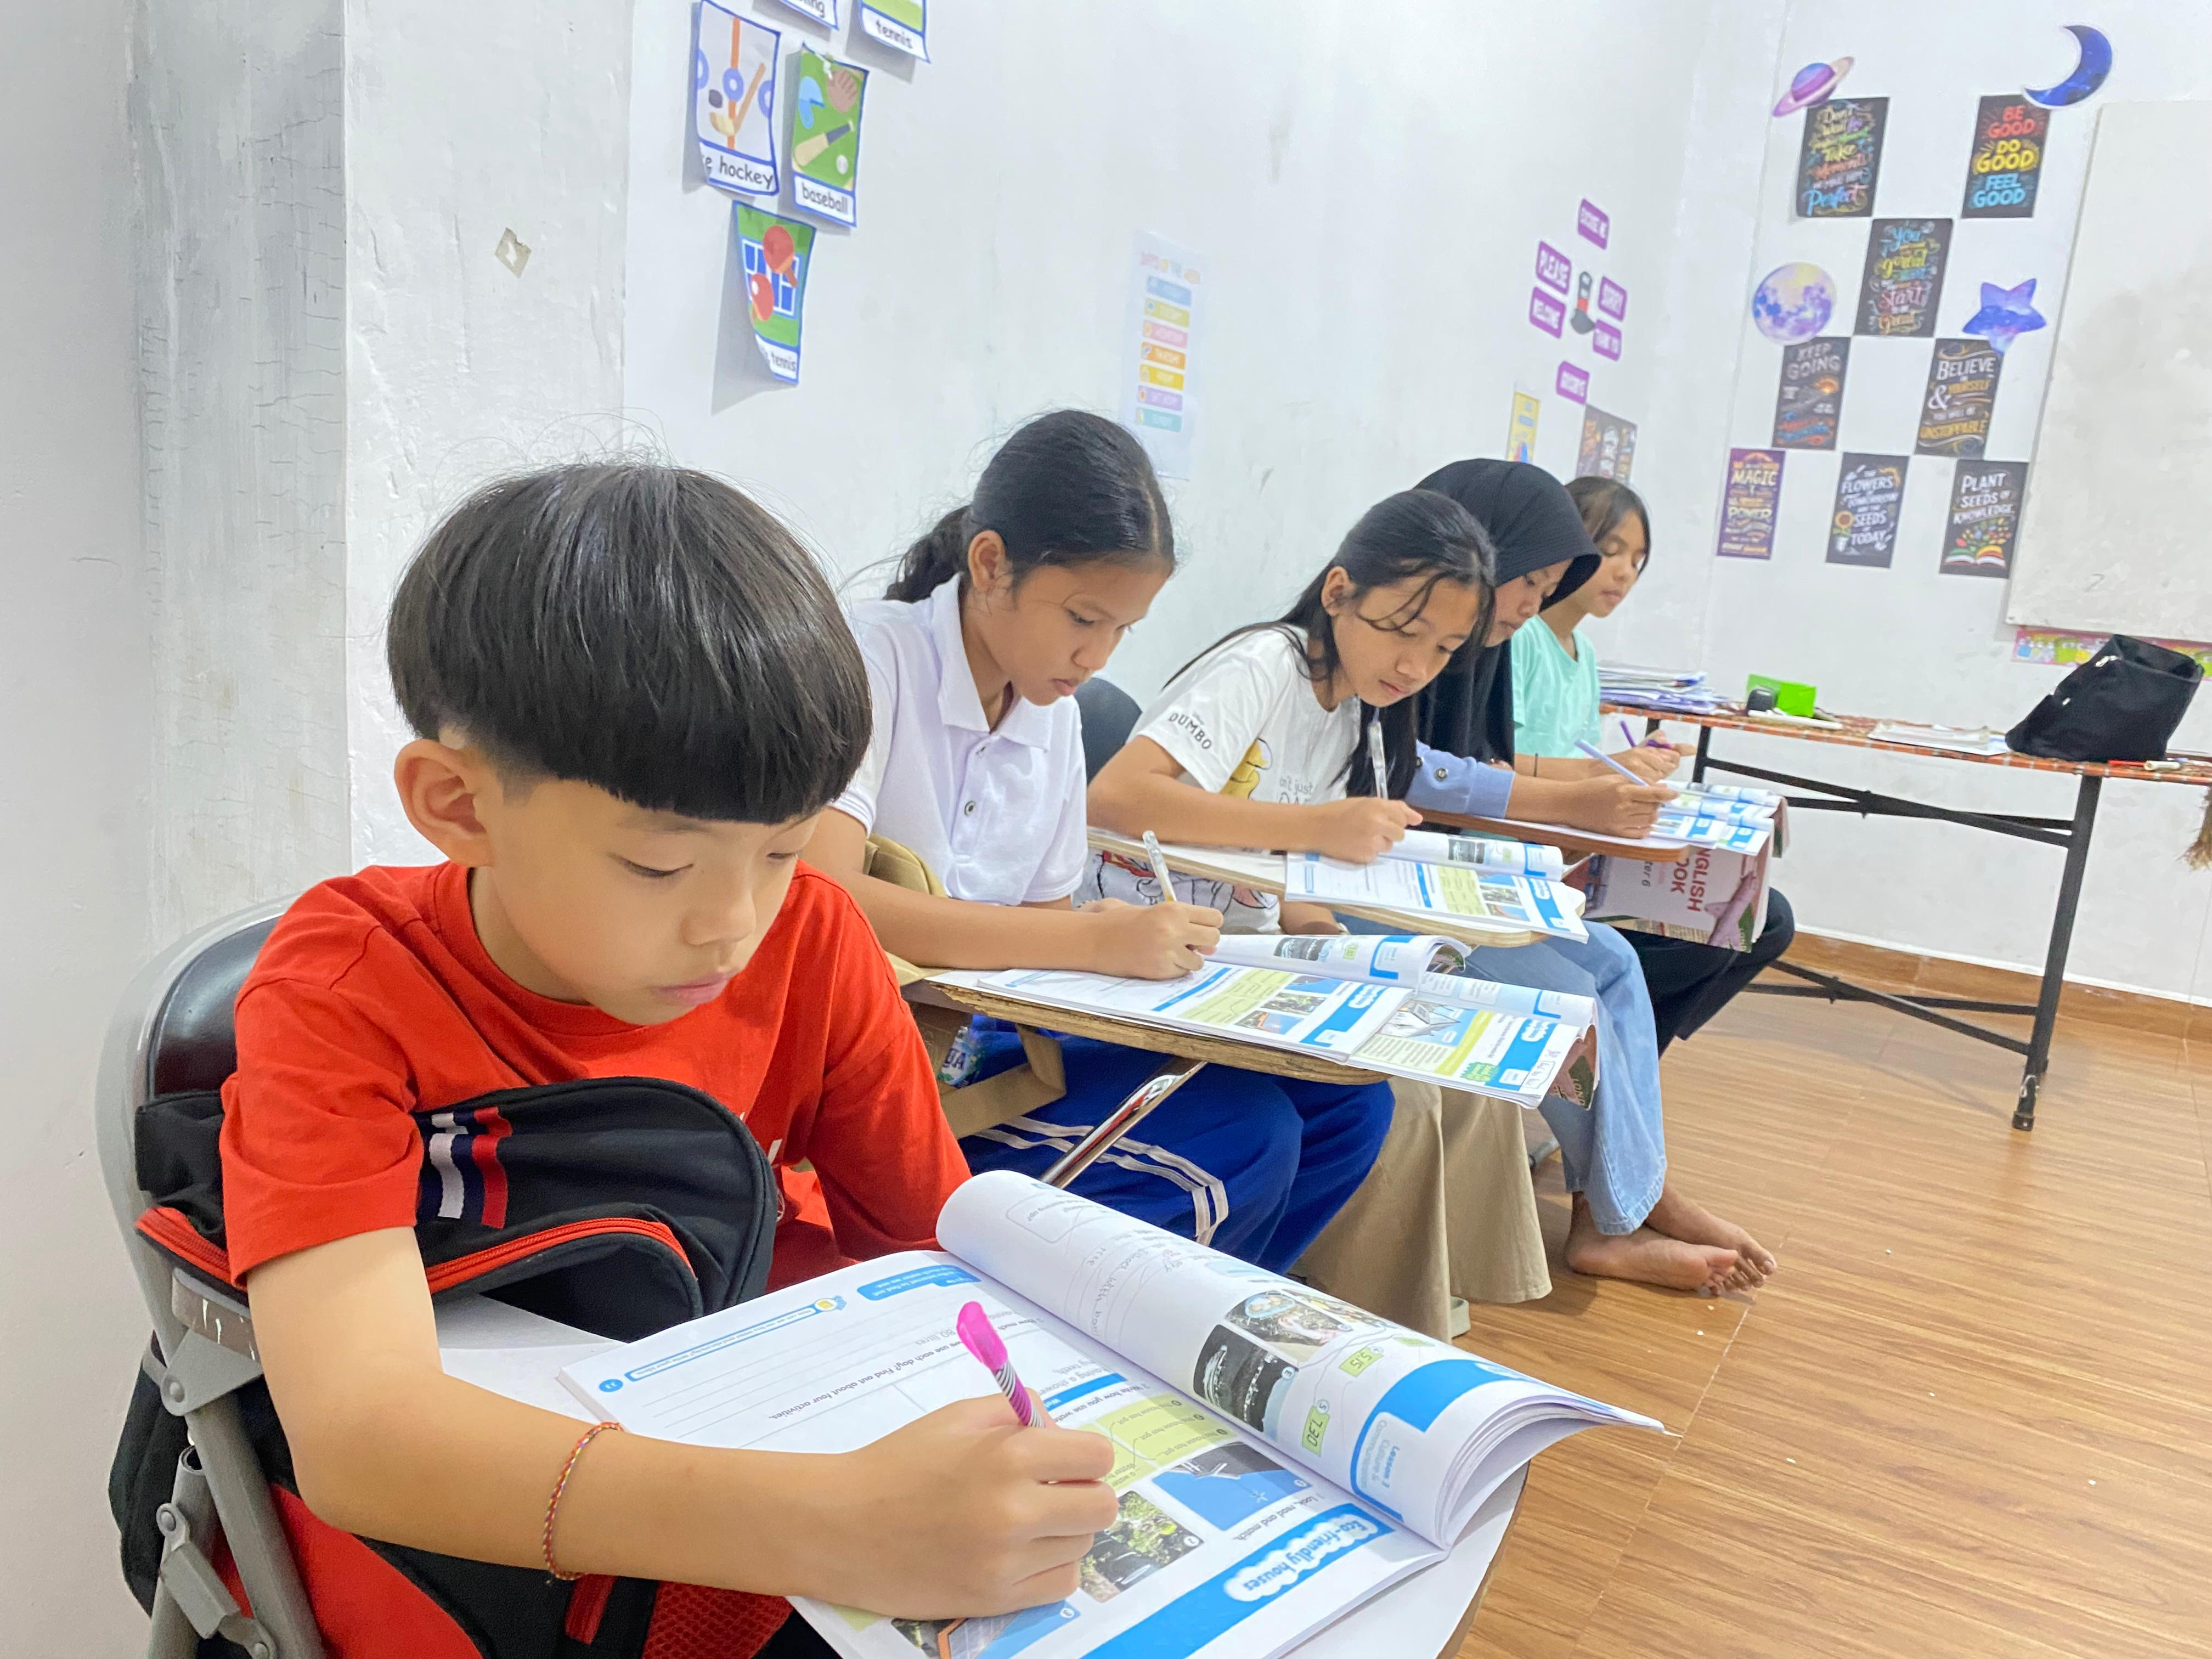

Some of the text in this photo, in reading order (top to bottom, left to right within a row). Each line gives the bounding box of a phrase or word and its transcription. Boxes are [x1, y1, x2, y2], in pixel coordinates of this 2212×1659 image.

[876, 20, 913, 49] tennis
[2004, 105, 2025, 121] BE
[1988, 118, 2036, 139] GOOD
[1997, 139, 2021, 154] DO
[1977, 149, 2034, 173] GOOD
[719, 155, 774, 190] hockey
[1985, 173, 2022, 191] FEEL
[802, 183, 848, 215] baseball
[1973, 188, 2025, 207] GOOD
[1787, 355, 1842, 380] GOING
[1936, 357, 1996, 380] BELIEVE
[1928, 385, 1951, 410] &
[1731, 469, 1778, 486] MAGIC
[1842, 476, 1893, 493] FLOWERS
[1961, 473, 2006, 493] PLANT
[1961, 492, 1998, 508] SEEDS
[1854, 510, 1887, 527] SEEDS
[1852, 530, 1887, 545] TODAY
[1167, 713, 1211, 749] DUMBO
[1294, 780, 1313, 795] just
[1687, 848, 1712, 911] NGLISH
[997, 1322, 1018, 1331] much
[914, 1328, 955, 1347] 80 litres
[915, 1350, 934, 1362] each
[935, 1344, 949, 1353] use
[895, 1358, 914, 1371] day?
[1350, 1352, 1372, 1370] 5.15
[858, 1375, 873, 1384] out
[874, 1367, 894, 1378] Find
[831, 1381, 857, 1395] about
[1103, 1390, 1122, 1401] how
[812, 1392, 831, 1403] four
[1086, 1395, 1103, 1407] you
[769, 1401, 811, 1420] activities.
[1072, 1403, 1087, 1413] use
[1307, 1420, 1323, 1447] 7.30
[1384, 1446, 1400, 1479] Lesson
[1277, 1504, 1296, 1518] read
[1262, 1514, 1277, 1526] and
[1232, 1522, 1261, 1541] match.
[1242, 1520, 1368, 1592] Eco-friendly houses
